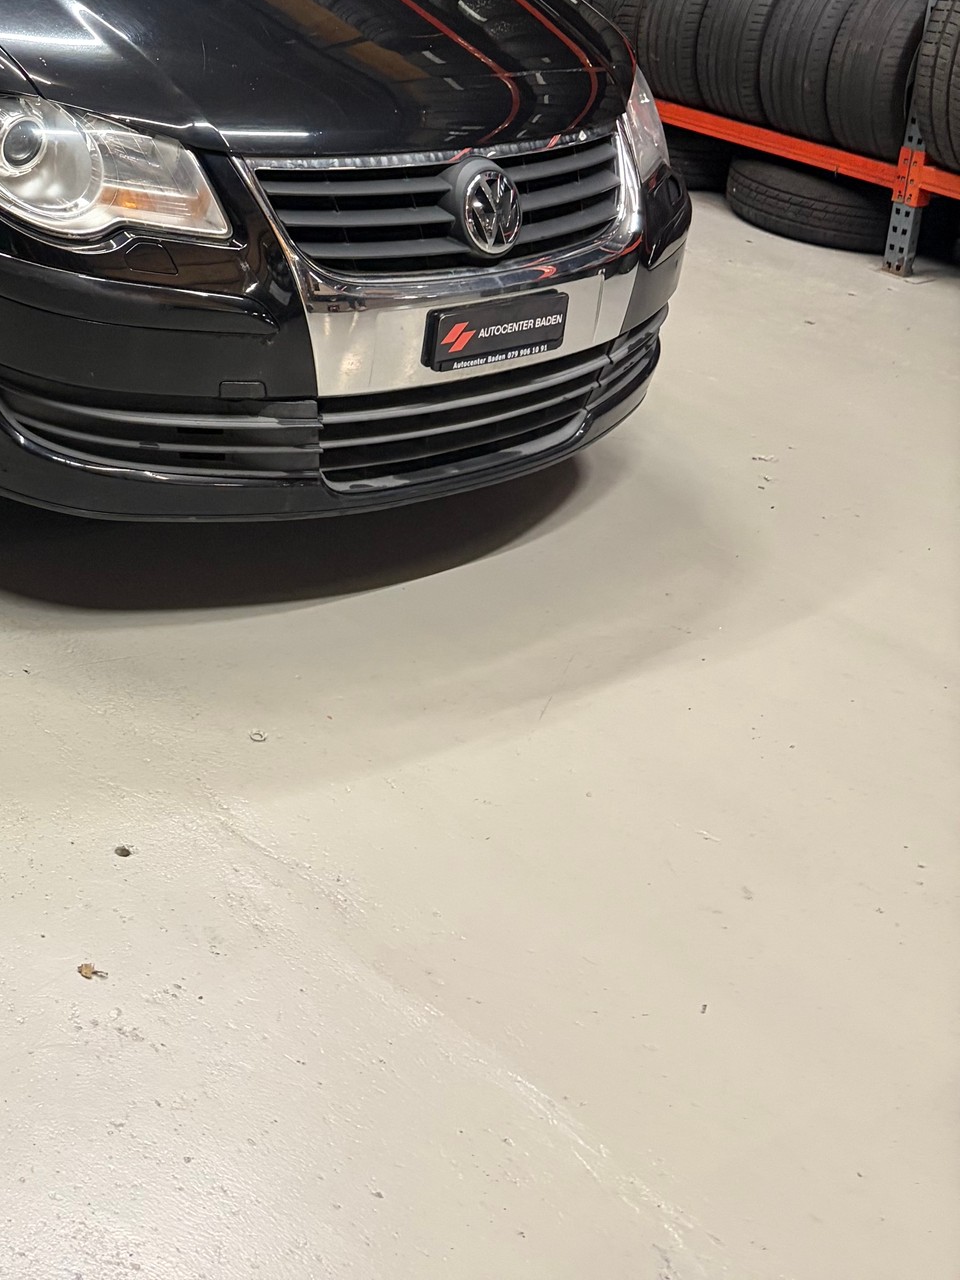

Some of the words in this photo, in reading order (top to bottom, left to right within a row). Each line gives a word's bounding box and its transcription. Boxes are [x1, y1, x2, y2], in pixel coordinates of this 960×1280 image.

[478, 319, 534, 338] AUTOCENTER
[535, 313, 563, 329] BADEN
[452, 357, 486, 370] Autocenter
[487, 353, 506, 363] Baden
